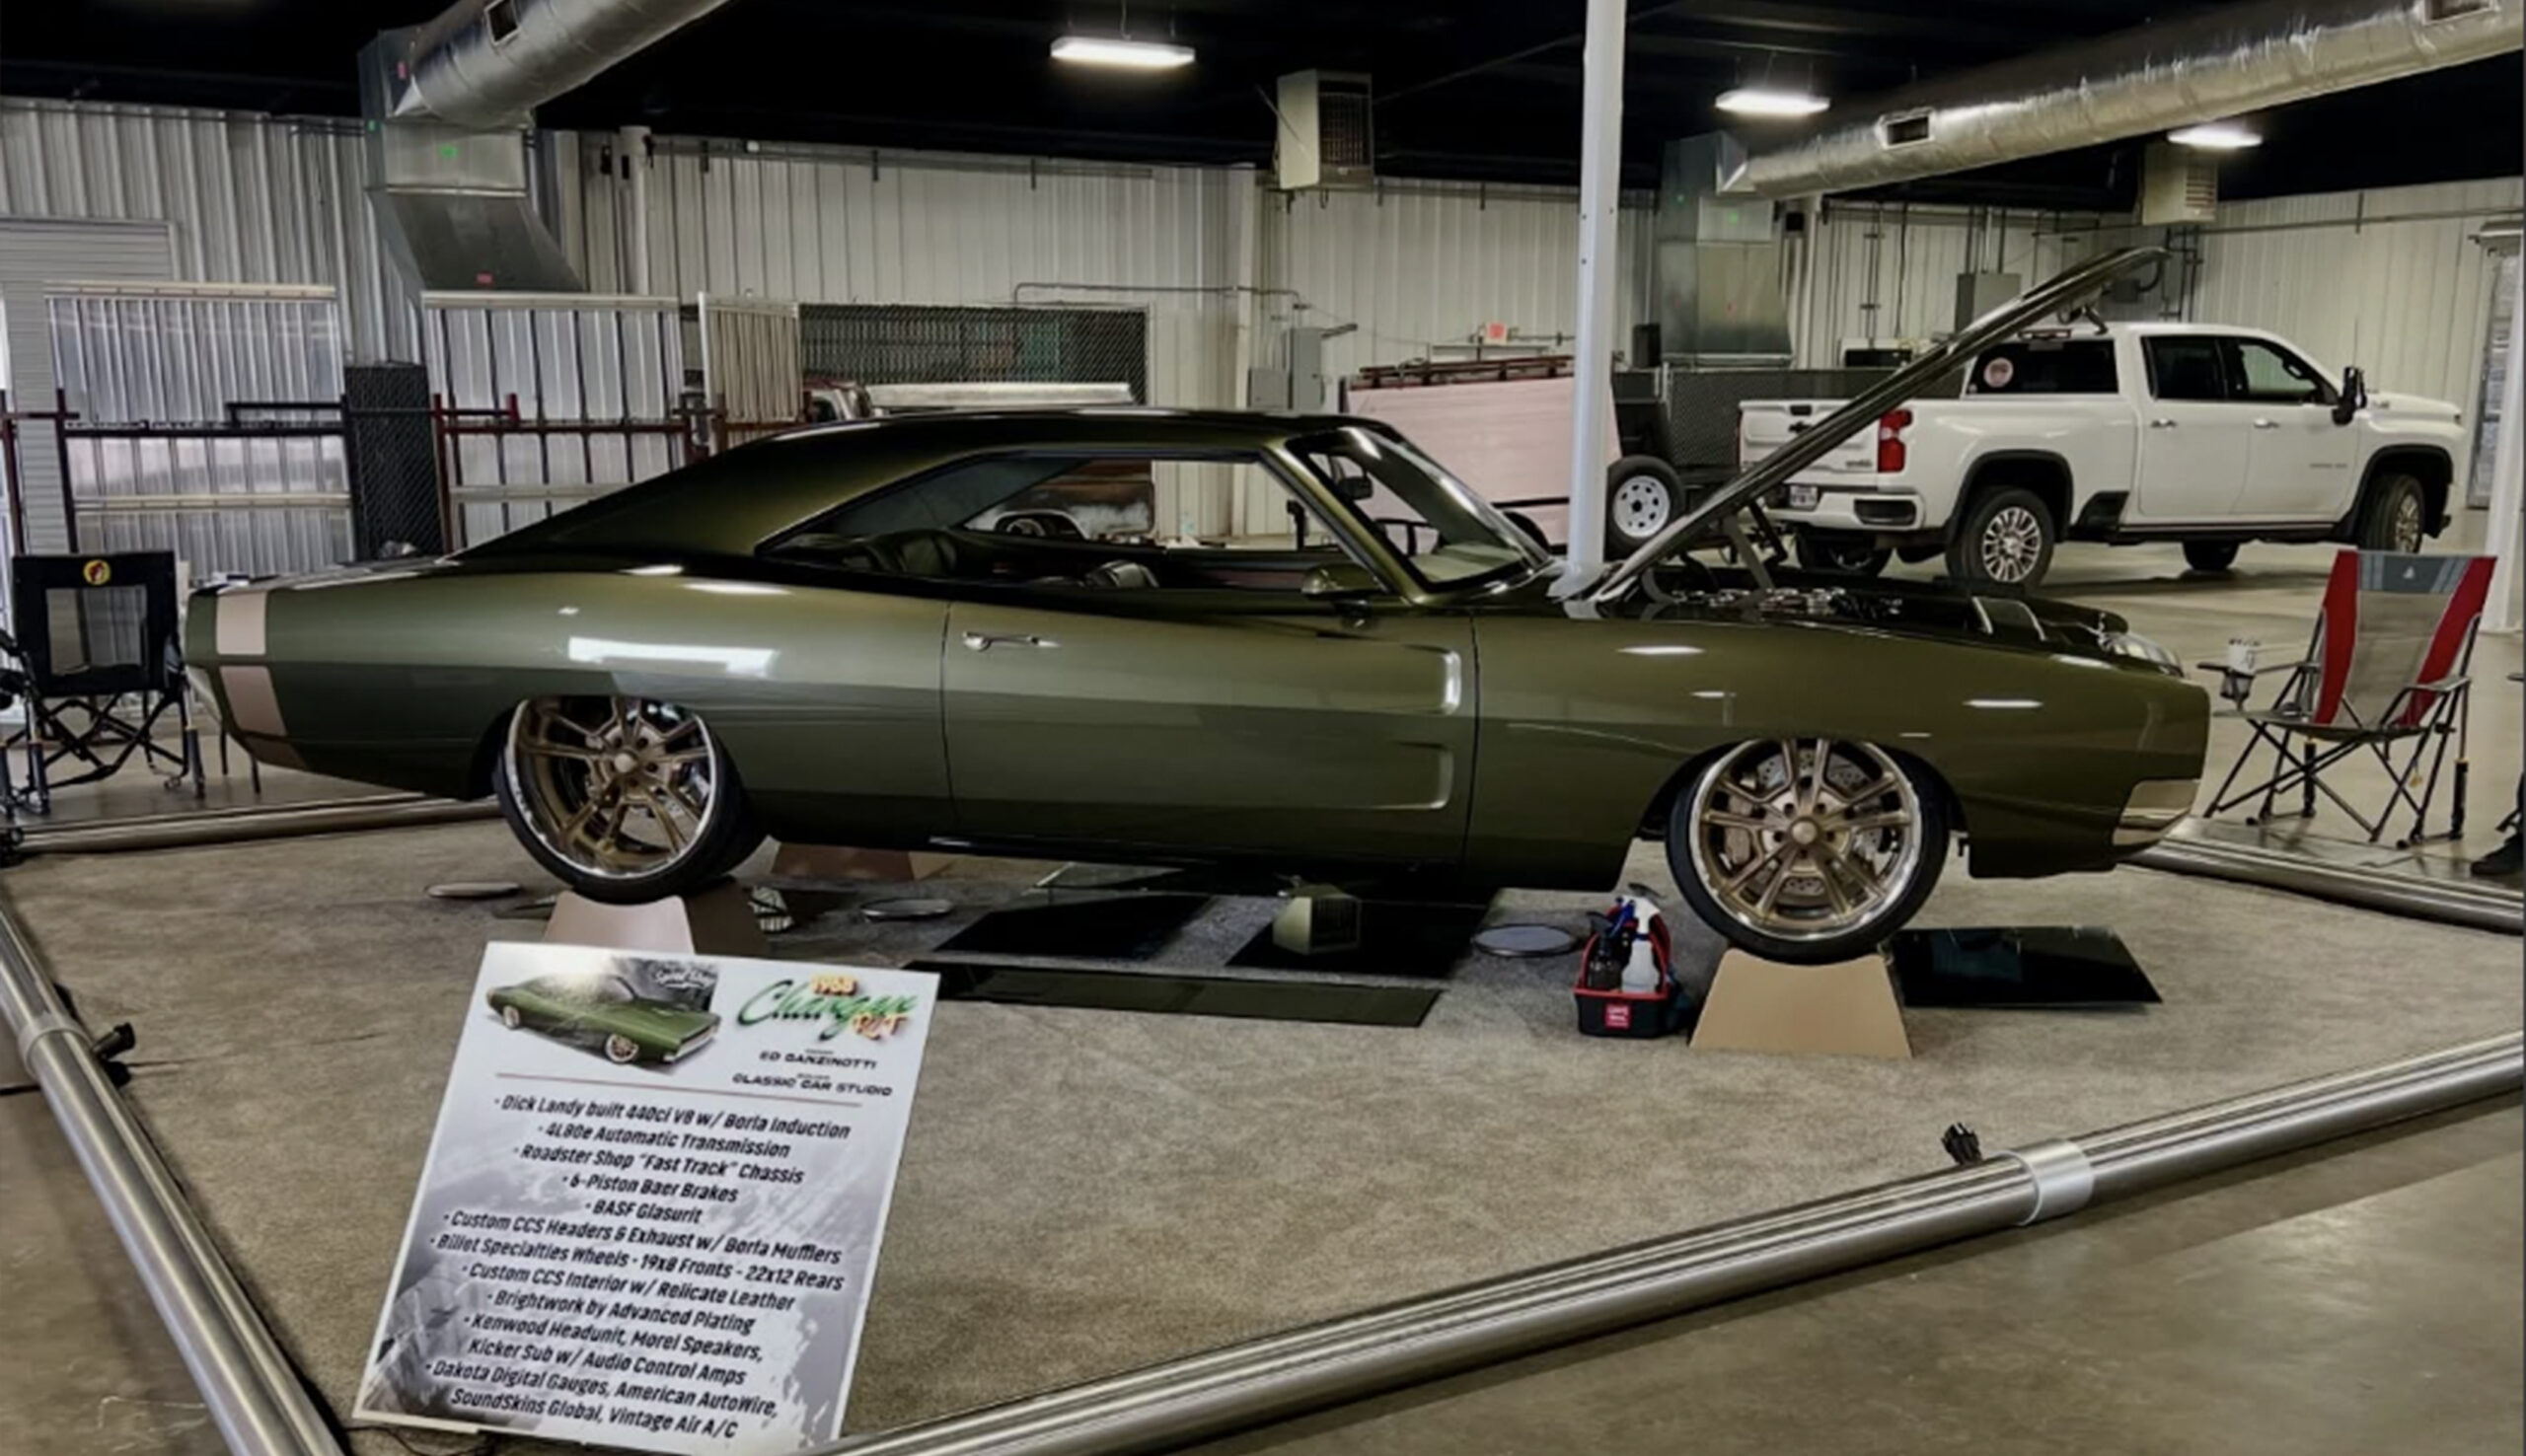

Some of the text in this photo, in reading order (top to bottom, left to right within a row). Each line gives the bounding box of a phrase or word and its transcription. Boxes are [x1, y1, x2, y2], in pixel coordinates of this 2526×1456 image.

[732, 1073, 796, 1088] CLASSIC
[800, 1079, 833, 1092] CAR
[835, 1082, 893, 1097] STUDIO
[502, 1096, 535, 1111] Dick
[539, 1099, 585, 1118] Landy
[587, 1102, 624, 1118] built
[675, 1110, 695, 1125] V8
[697, 1112, 723, 1128] w/
[771, 1118, 851, 1139] Induction
[521, 1145, 591, 1164] Roadster
[593, 1151, 633, 1170] Shop
[739, 1164, 804, 1184] Chassis
[594, 1127, 680, 1147] Automatic
[681, 1134, 790, 1158] Transmission
[571, 1174, 738, 1202] 6-Piston Baer Brakes
[593, 1201, 703, 1223] BASF Glasurit
[451, 1211, 510, 1229] Custom
[512, 1216, 545, 1233] CCS
[547, 1219, 613, 1241] Headers
[629, 1227, 694, 1248] Exhaust
[696, 1234, 724, 1252] w/
[772, 1242, 842, 1264] Mufflers
[438, 1236, 481, 1252] Billet
[482, 1239, 569, 1262] Specialties
[572, 1247, 630, 1267] Wheels
[641, 1254, 678, 1272] 19x8
[679, 1259, 733, 1278] Fronts
[746, 1266, 794, 1285] 22x12
[794, 1272, 845, 1290] Rears
[470, 1264, 796, 1311] Custom CCS Interior w/ Relicate Leather
[495, 1290, 756, 1336] Brightwork by Advanced Plating
[472, 1314, 763, 1363] Kenwood Headunit, Morel Speakers,
[434, 1361, 489, 1381] Dakota
[491, 1367, 547, 1388] Digital
[547, 1373, 611, 1398] Gauges,
[615, 1381, 697, 1406] American
[468, 1339, 747, 1386] Kicker Sub w/ Audio Control Amps
[452, 1388, 739, 1438] SoundSkins Global, Vintage Air A/C
